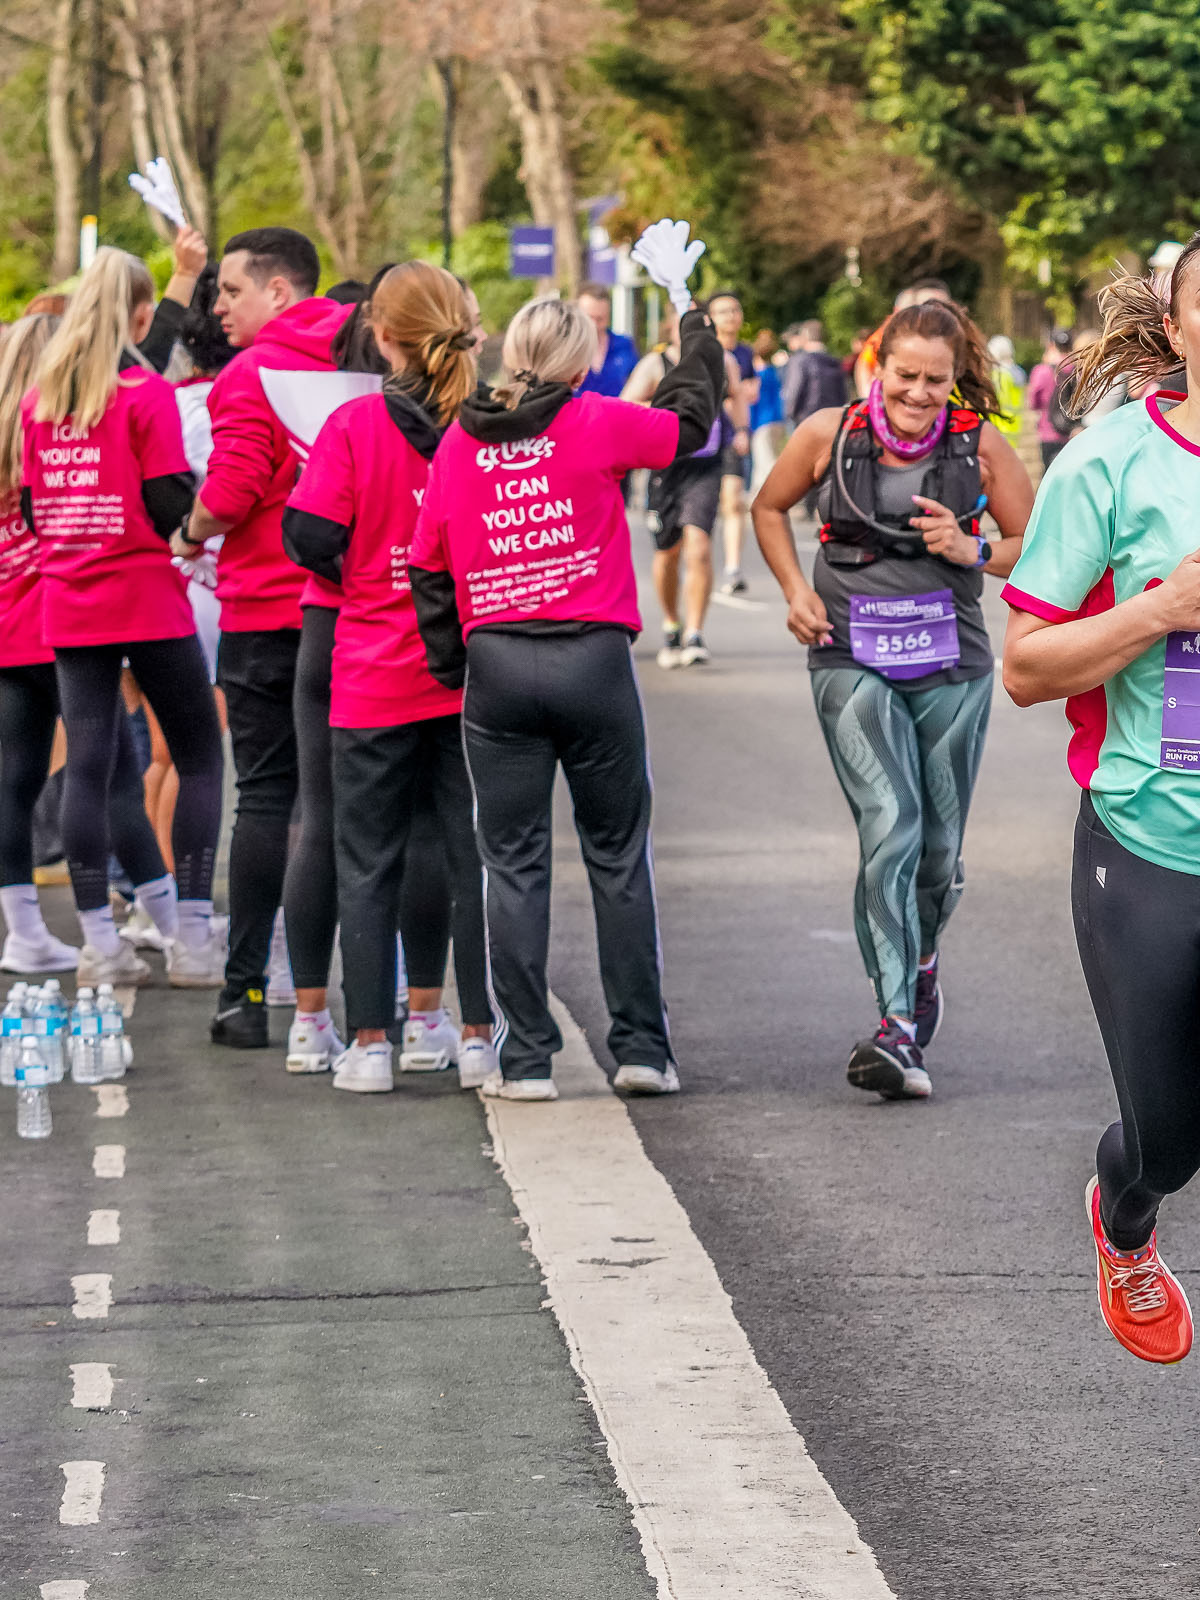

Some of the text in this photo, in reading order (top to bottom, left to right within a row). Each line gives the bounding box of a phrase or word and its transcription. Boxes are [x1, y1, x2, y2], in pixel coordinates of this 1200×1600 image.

[38, 447, 101, 466] YOU CAN
[42, 469, 100, 488] WE CAN!
[494, 475, 550, 501] I CAN
[481, 498, 573, 531] YOU CAN
[488, 524, 576, 556] WE CAN!
[876, 630, 932, 653] 5566
[1167, 697, 1177, 709] S
[1165, 752, 1182, 761] RUN
[1183, 754, 1198, 762] FOR
